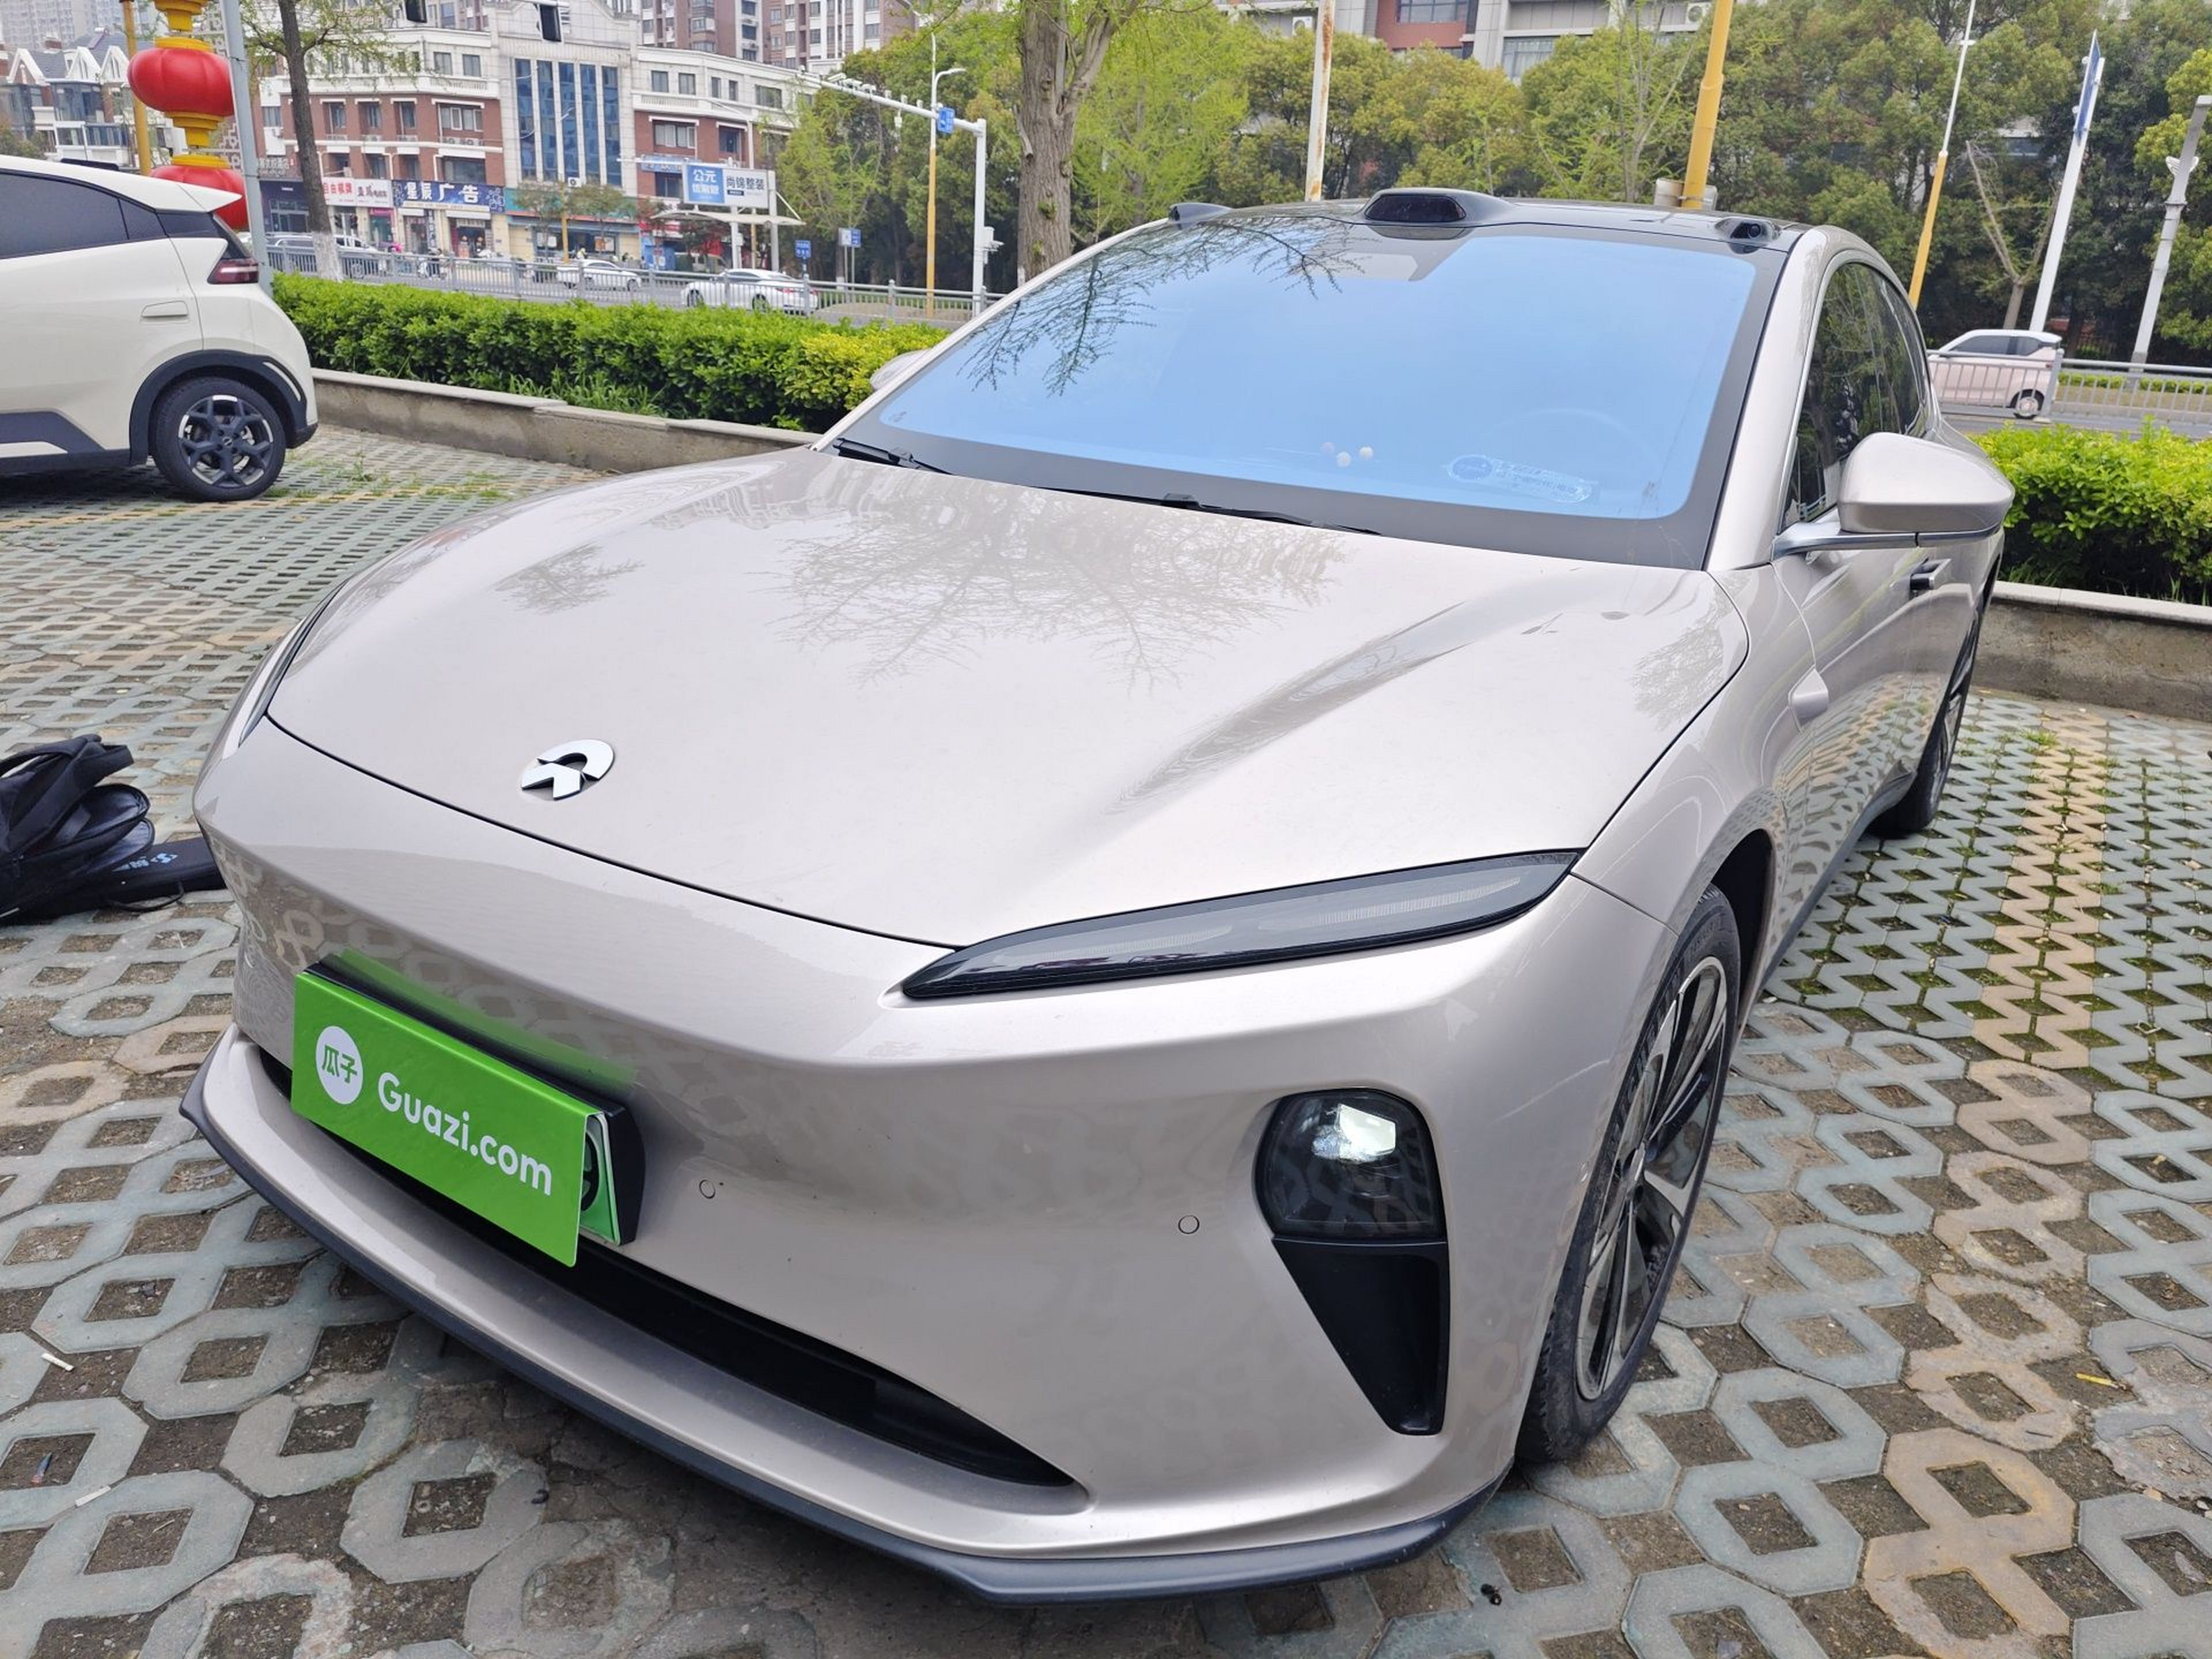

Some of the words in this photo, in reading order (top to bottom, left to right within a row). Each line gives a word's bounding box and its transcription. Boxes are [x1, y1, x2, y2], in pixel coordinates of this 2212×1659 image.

[693, 169, 717, 183] 公元
[726, 176, 764, 191] 尚锦整装
[404, 181, 479, 203] 星辰广告
[321, 1044, 358, 1084] 瓜子
[377, 1072, 552, 1196] Guazi.com
